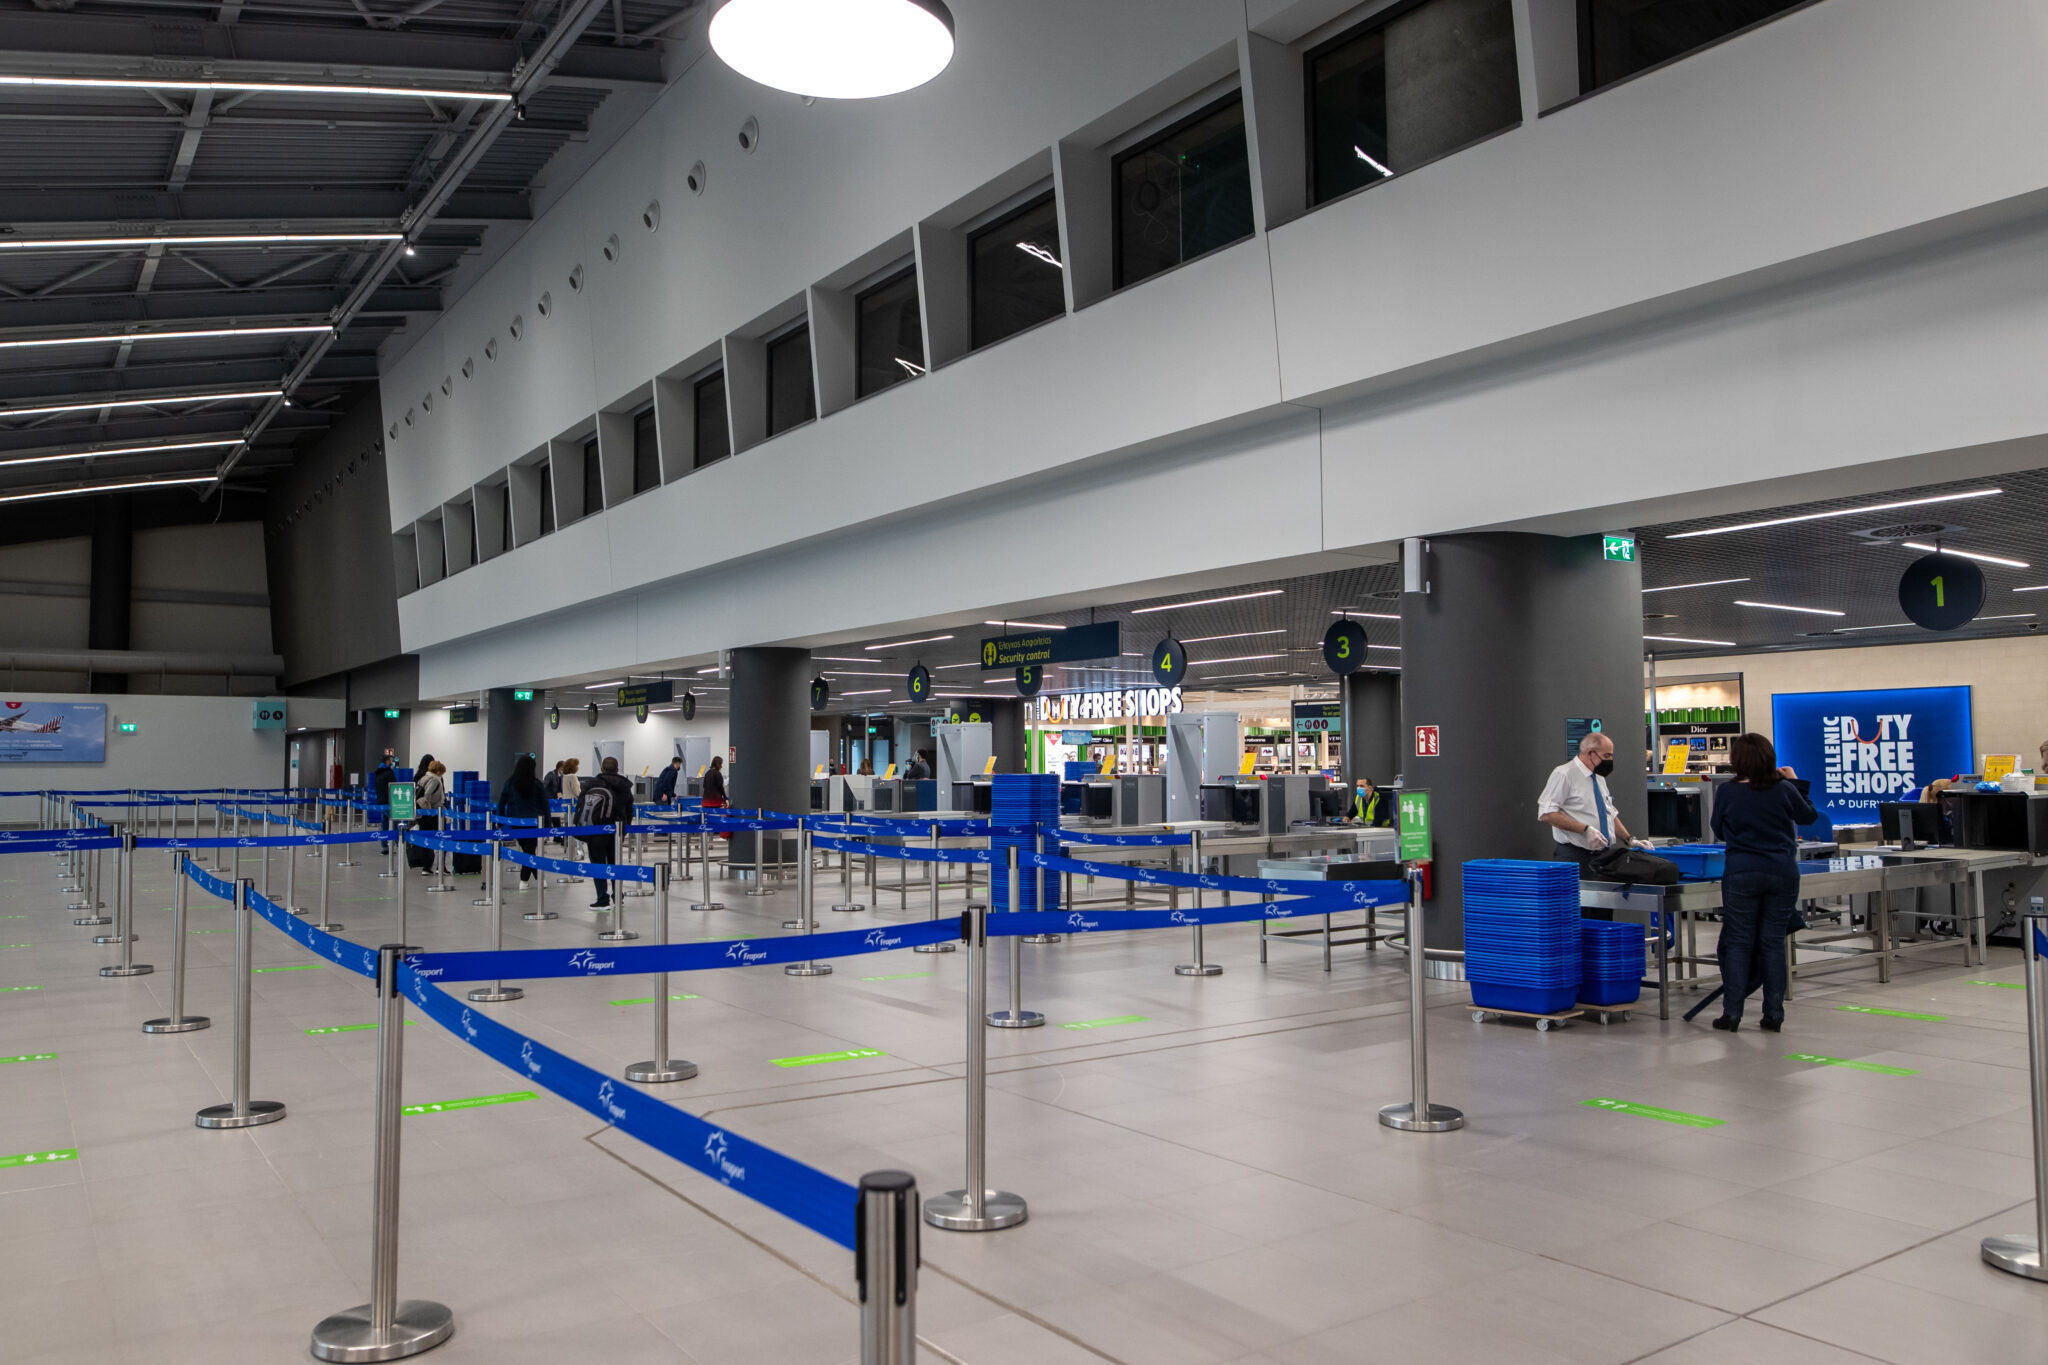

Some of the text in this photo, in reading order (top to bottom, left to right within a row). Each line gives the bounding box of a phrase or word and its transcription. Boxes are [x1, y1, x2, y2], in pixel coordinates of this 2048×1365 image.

[1930, 576, 1944, 607] 1
[1337, 636, 1349, 658] 3
[998, 649, 1050, 664] Security control
[1161, 653, 1172, 672] 4
[1023, 666, 1032, 684] 5
[913, 677, 921, 693] 6
[815, 687, 821, 702] 7
[1082, 691, 1123, 719] FREE
[1823, 716, 1842, 793] HELLENIC
[1841, 741, 1914, 771] FREE
[1843, 772, 1916, 794] SHOPS
[1827, 800, 1835, 808] A
[880, 936, 902, 946] Fraport
[743, 950, 767, 961] Fraport
[587, 960, 615, 970] Fraport
